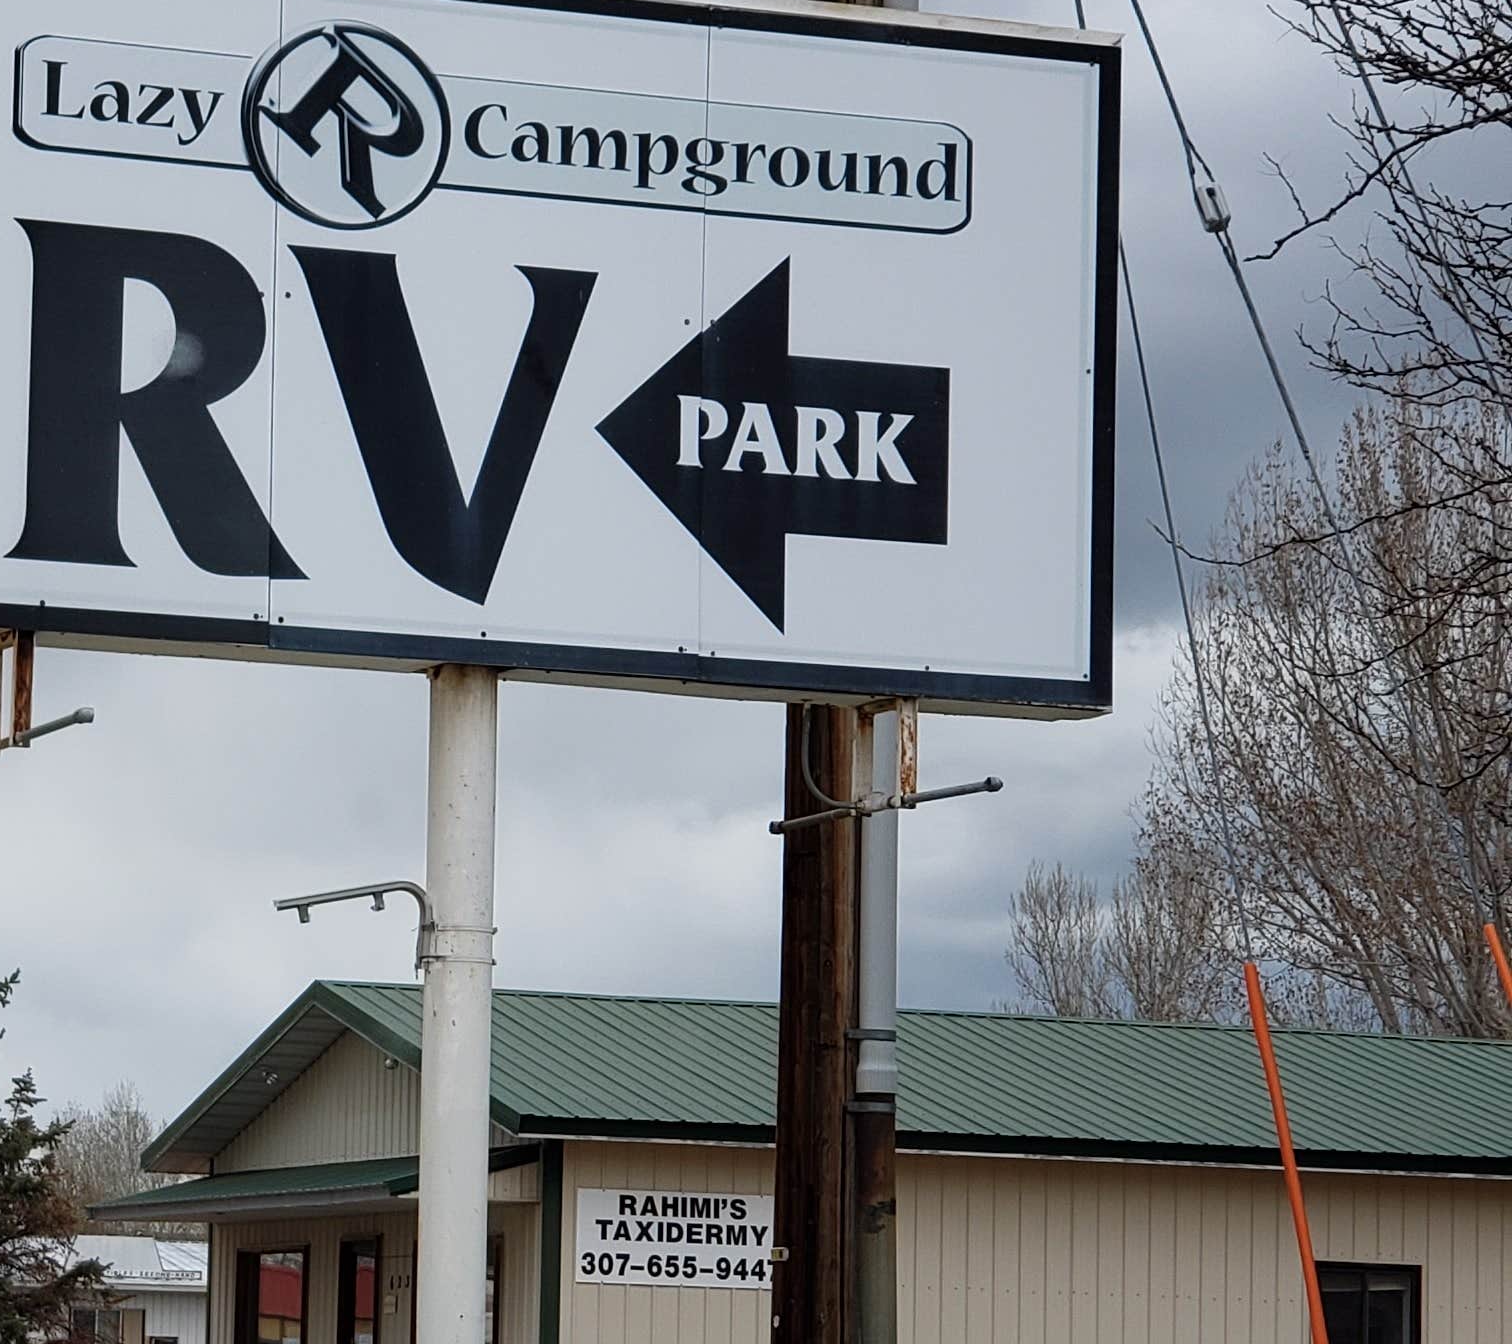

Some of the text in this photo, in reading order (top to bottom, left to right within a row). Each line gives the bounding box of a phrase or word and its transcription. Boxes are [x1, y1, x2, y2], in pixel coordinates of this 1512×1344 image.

[40, 60, 225, 145] Lazy
[463, 103, 962, 202] Campground
[4, 218, 919, 606] RV PARK
[595, 1219, 769, 1246] TAXIDERMY
[619, 1194, 747, 1220] RAHIMI'S
